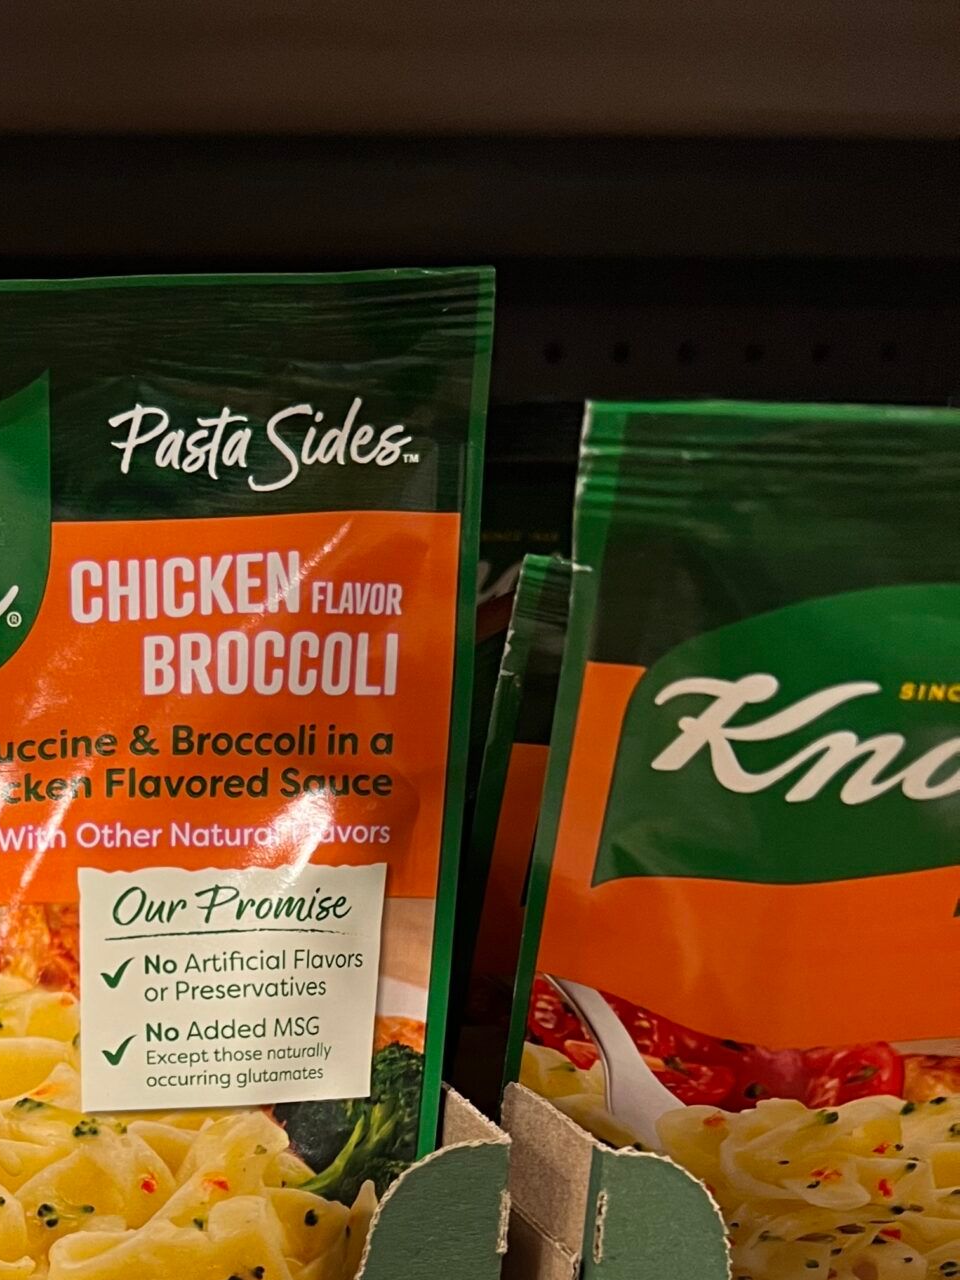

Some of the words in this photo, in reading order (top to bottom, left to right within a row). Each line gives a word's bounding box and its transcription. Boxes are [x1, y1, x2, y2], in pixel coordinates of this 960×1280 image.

[108, 403, 252, 480] Pasta
[70, 550, 301, 624] CHICKEN
[311, 580, 403, 616] FLAVOR
[143, 631, 398, 697] BROCCOLI
[129, 724, 159, 757] &
[171, 722, 315, 757] Broccoli
[327, 723, 358, 755] in
[370, 730, 394, 755] a
[105, 766, 269, 800] Flavored
[279, 765, 393, 798] Sauce
[76, 820, 162, 849] Other
[170, 819, 280, 847] Natural
[112, 885, 188, 927] Our
[194, 883, 352, 924] Promise
[143, 953, 178, 976] No
[184, 949, 287, 974] Artificial
[293, 948, 364, 971] Flavors
[144, 984, 169, 1002] or
[175, 976, 327, 1002] Preservatives
[145, 1022, 180, 1043] No
[186, 1017, 267, 1042] Added
[274, 1015, 320, 1038] MSG
[146, 1048, 209, 1069] Except
[214, 1044, 263, 1064] those
[266, 1041, 332, 1062] naturally
[146, 1070, 231, 1089] occurring
[236, 1065, 325, 1089] glutamates
